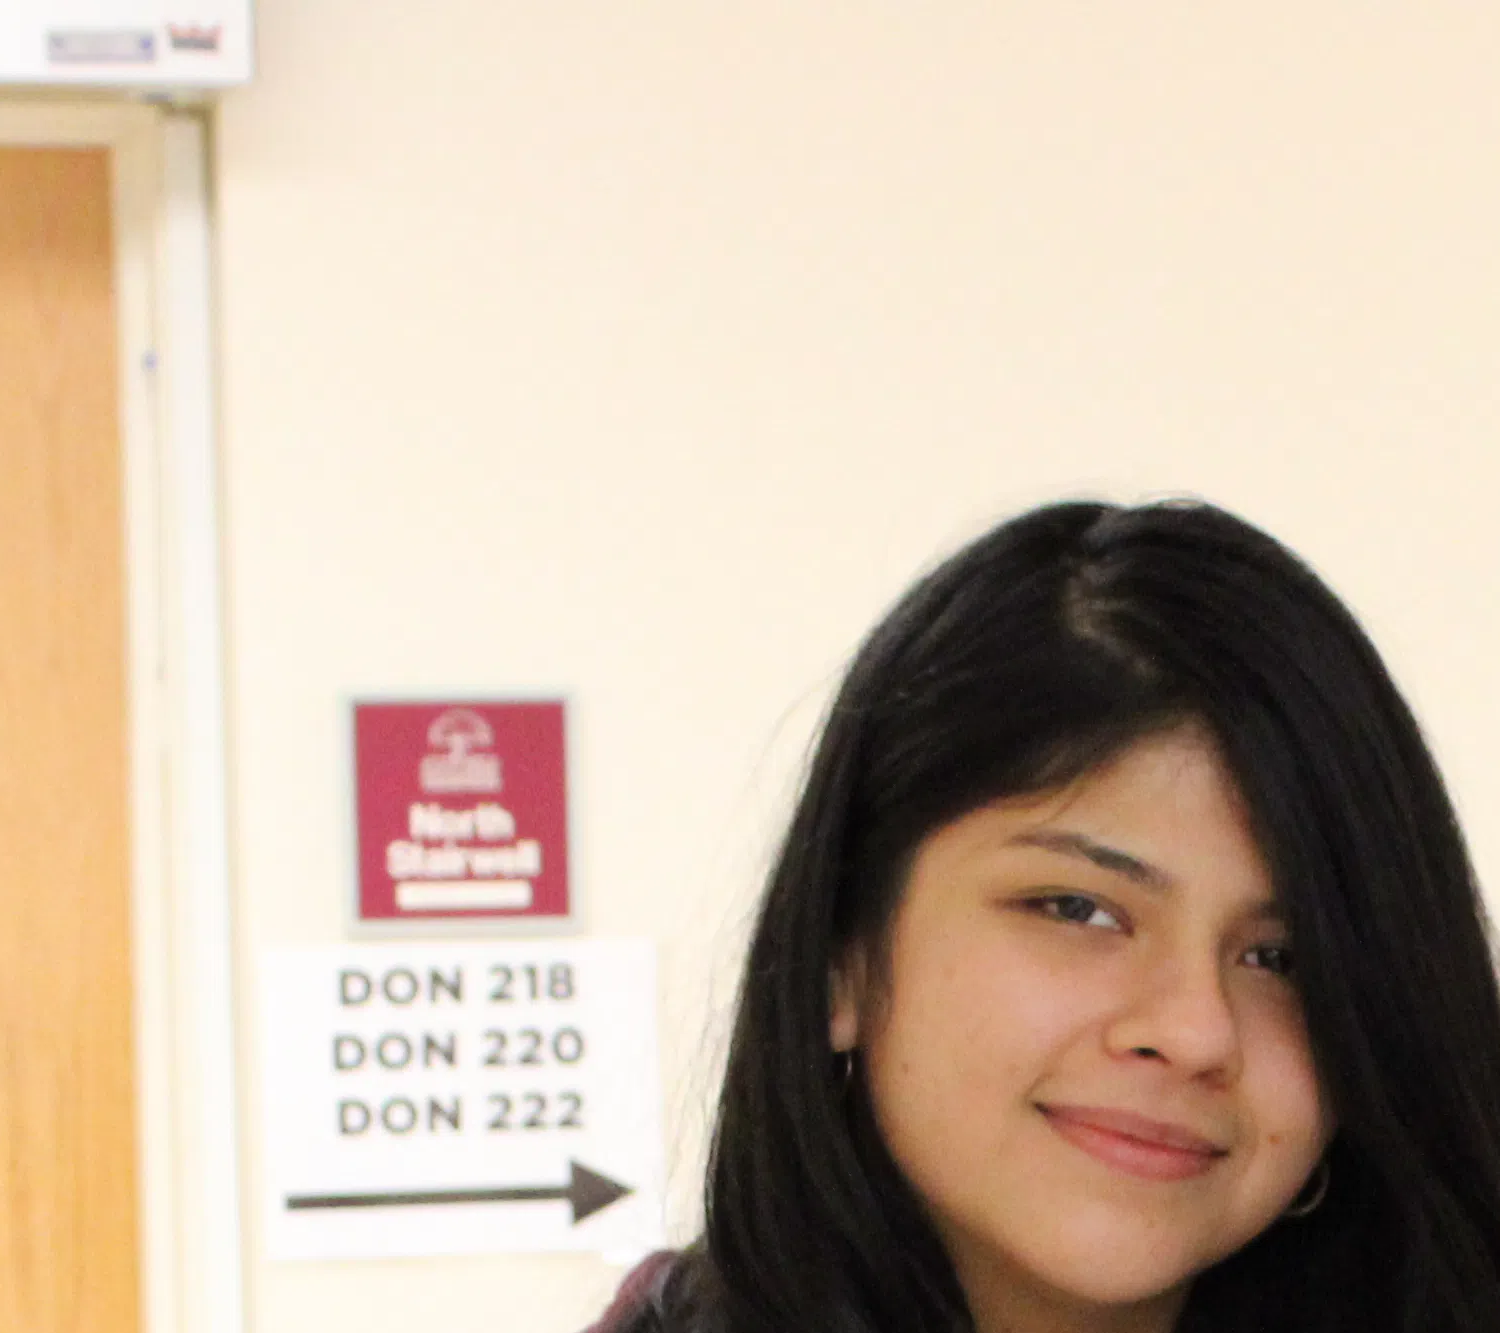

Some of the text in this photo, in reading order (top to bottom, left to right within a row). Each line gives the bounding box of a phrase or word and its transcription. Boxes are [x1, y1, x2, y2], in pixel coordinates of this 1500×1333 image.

[338, 964, 576, 1006] DON 218
[333, 1028, 586, 1071] DON 220
[338, 1094, 585, 1136] DON 222
